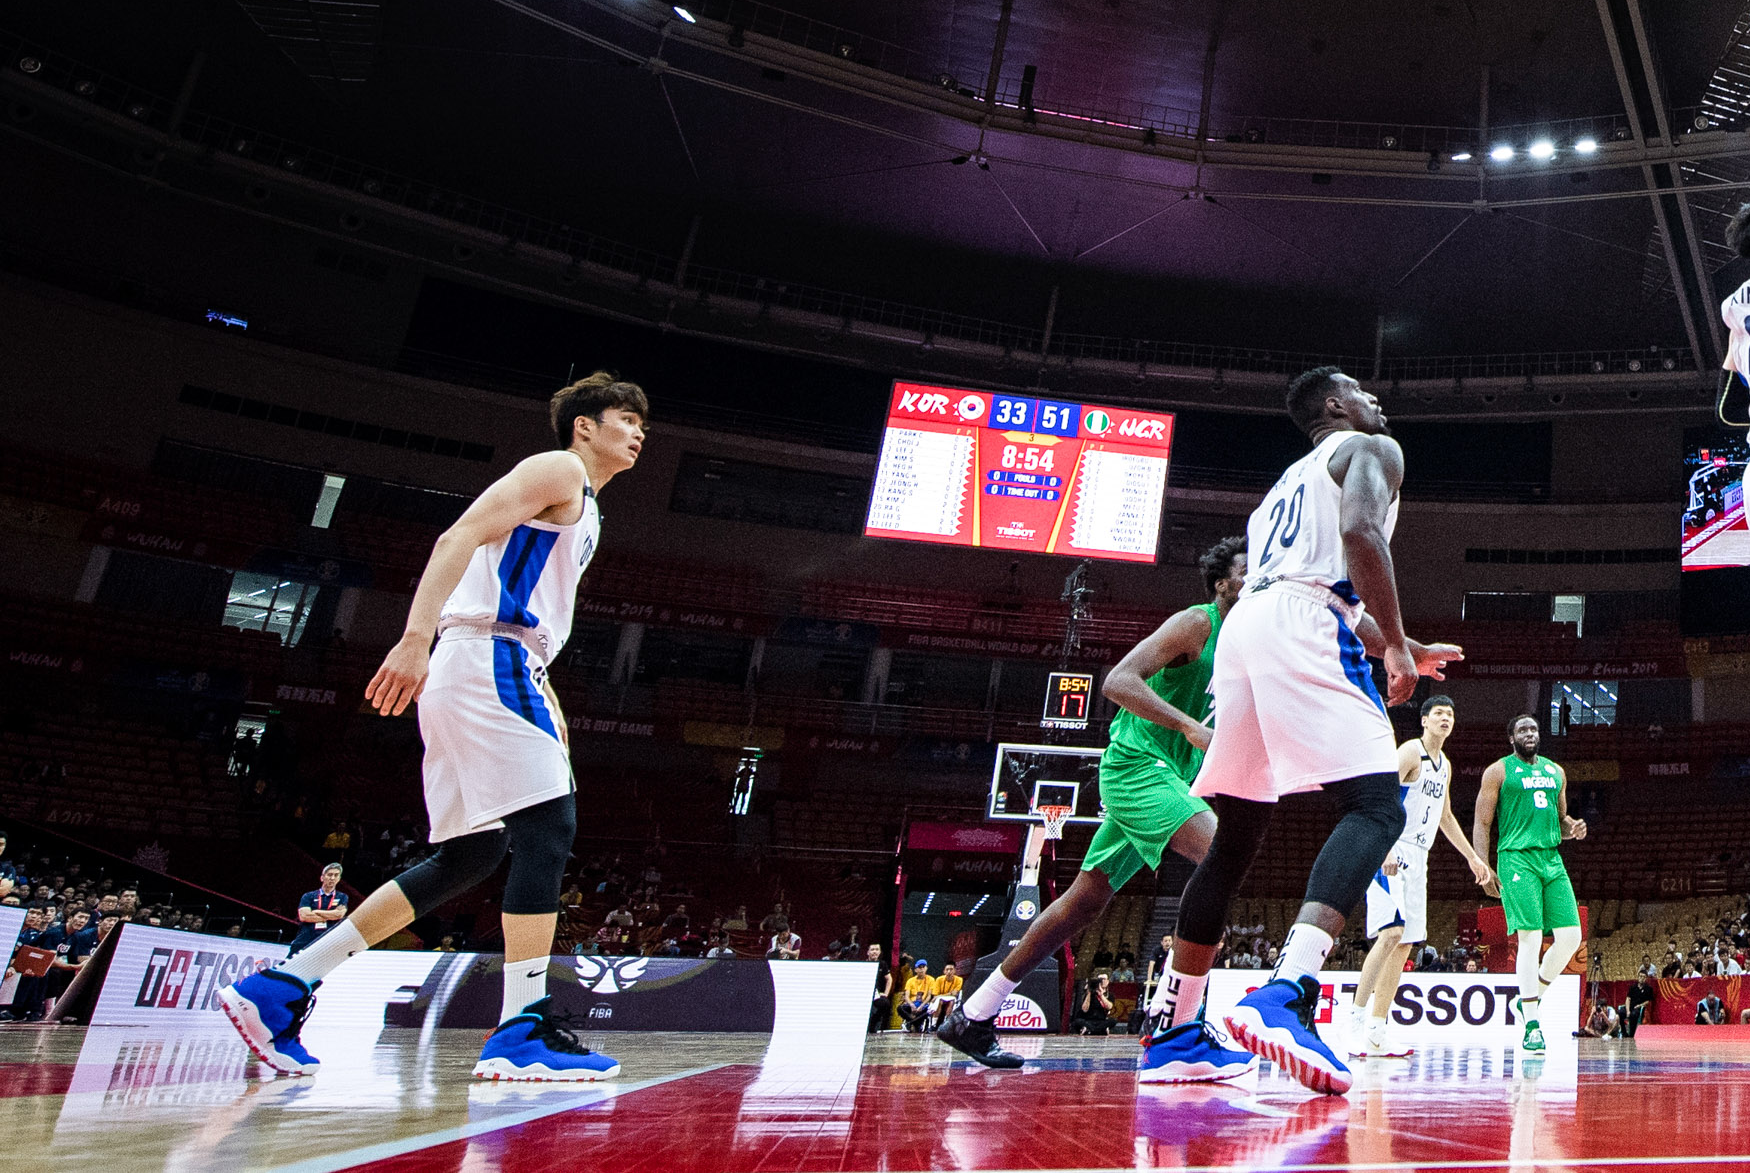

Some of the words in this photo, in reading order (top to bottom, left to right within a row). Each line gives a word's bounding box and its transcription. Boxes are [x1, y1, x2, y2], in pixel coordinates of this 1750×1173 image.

[897, 390, 950, 415] KOR
[996, 400, 1027, 425] 33
[1041, 405, 1070, 430] 51
[1028, 434, 1035, 442] 3
[1118, 418, 1166, 440] NGR
[1001, 445, 1055, 472] 8:54
[993, 471, 1001, 481] 0
[1049, 477, 1057, 486] 0
[991, 484, 999, 494] 0
[1007, 487, 1025, 496] TIME
[1024, 489, 1039, 498] OUT
[1046, 490, 1054, 500] 0
[996, 527, 1036, 537] TISSOT
[1258, 483, 1305, 568] 20
[126, 531, 185, 553] WUHAN
[930, 635, 987, 651] BASKETBALL
[987, 640, 1019, 653] WORLD
[1020, 643, 1039, 654] CUP
[1489, 663, 1541, 675] BASKETBALL
[1541, 664, 1572, 675] WORLD
[1572, 664, 1589, 675] CUP
[1592, 662, 1629, 675] China
[1631, 662, 1659, 675] 2019
[1059, 678, 1089, 692] 8:54
[1061, 694, 1085, 717] 17
[1054, 722, 1088, 730] TISSOT
[1421, 779, 1444, 799] KOREA
[1521, 777, 1556, 789] NIGERIA
[1533, 790, 1548, 809] 6
[953, 859, 1005, 874] WUHAN
[589, 1007, 612, 1018] FIBA
[993, 1010, 1042, 1027] anten
